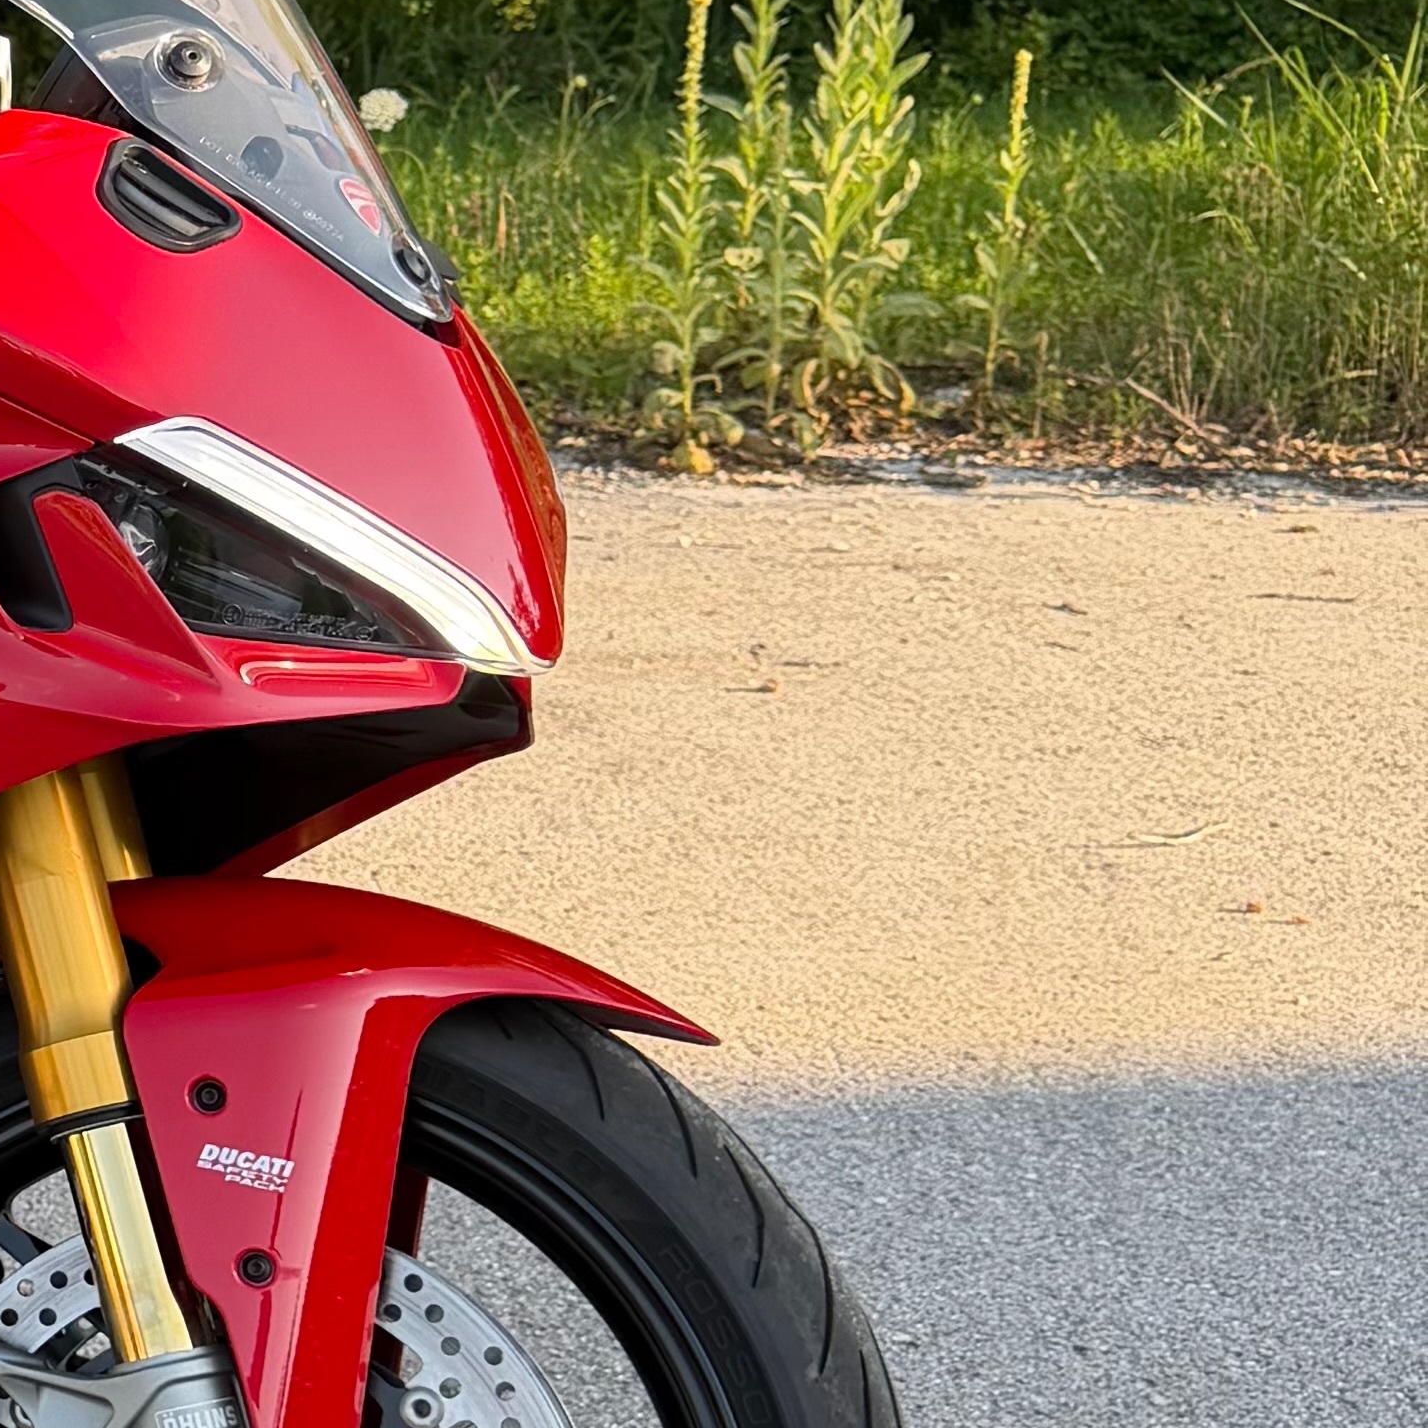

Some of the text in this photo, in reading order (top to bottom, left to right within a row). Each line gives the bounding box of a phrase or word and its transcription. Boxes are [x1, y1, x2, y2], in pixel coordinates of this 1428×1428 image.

[196, 1159, 289, 1185] SAFETY
[199, 1143, 295, 1177] DUCATI
[224, 1173, 287, 1194] PACK
[659, 1246, 774, 1427] ROSSO
